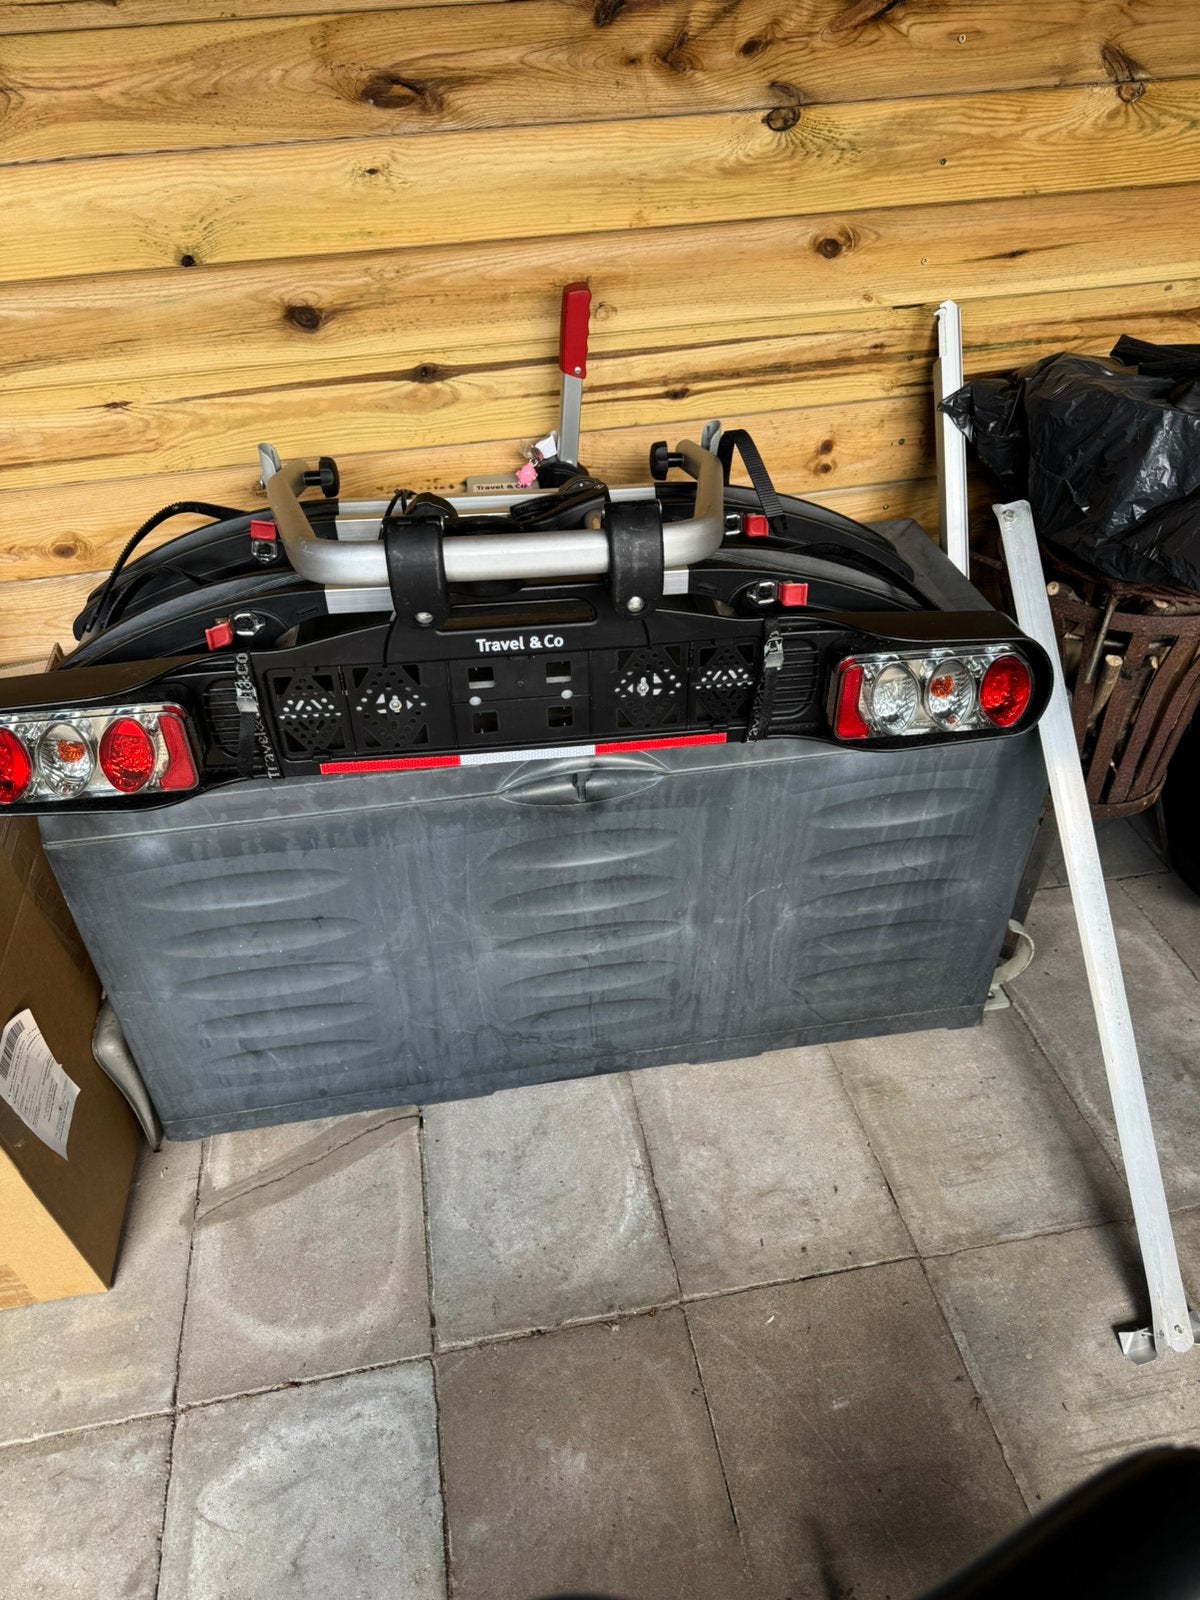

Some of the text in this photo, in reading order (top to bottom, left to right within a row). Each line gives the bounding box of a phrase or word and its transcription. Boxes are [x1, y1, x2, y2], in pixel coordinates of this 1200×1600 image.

[475, 634, 564, 652] Travel & Co
